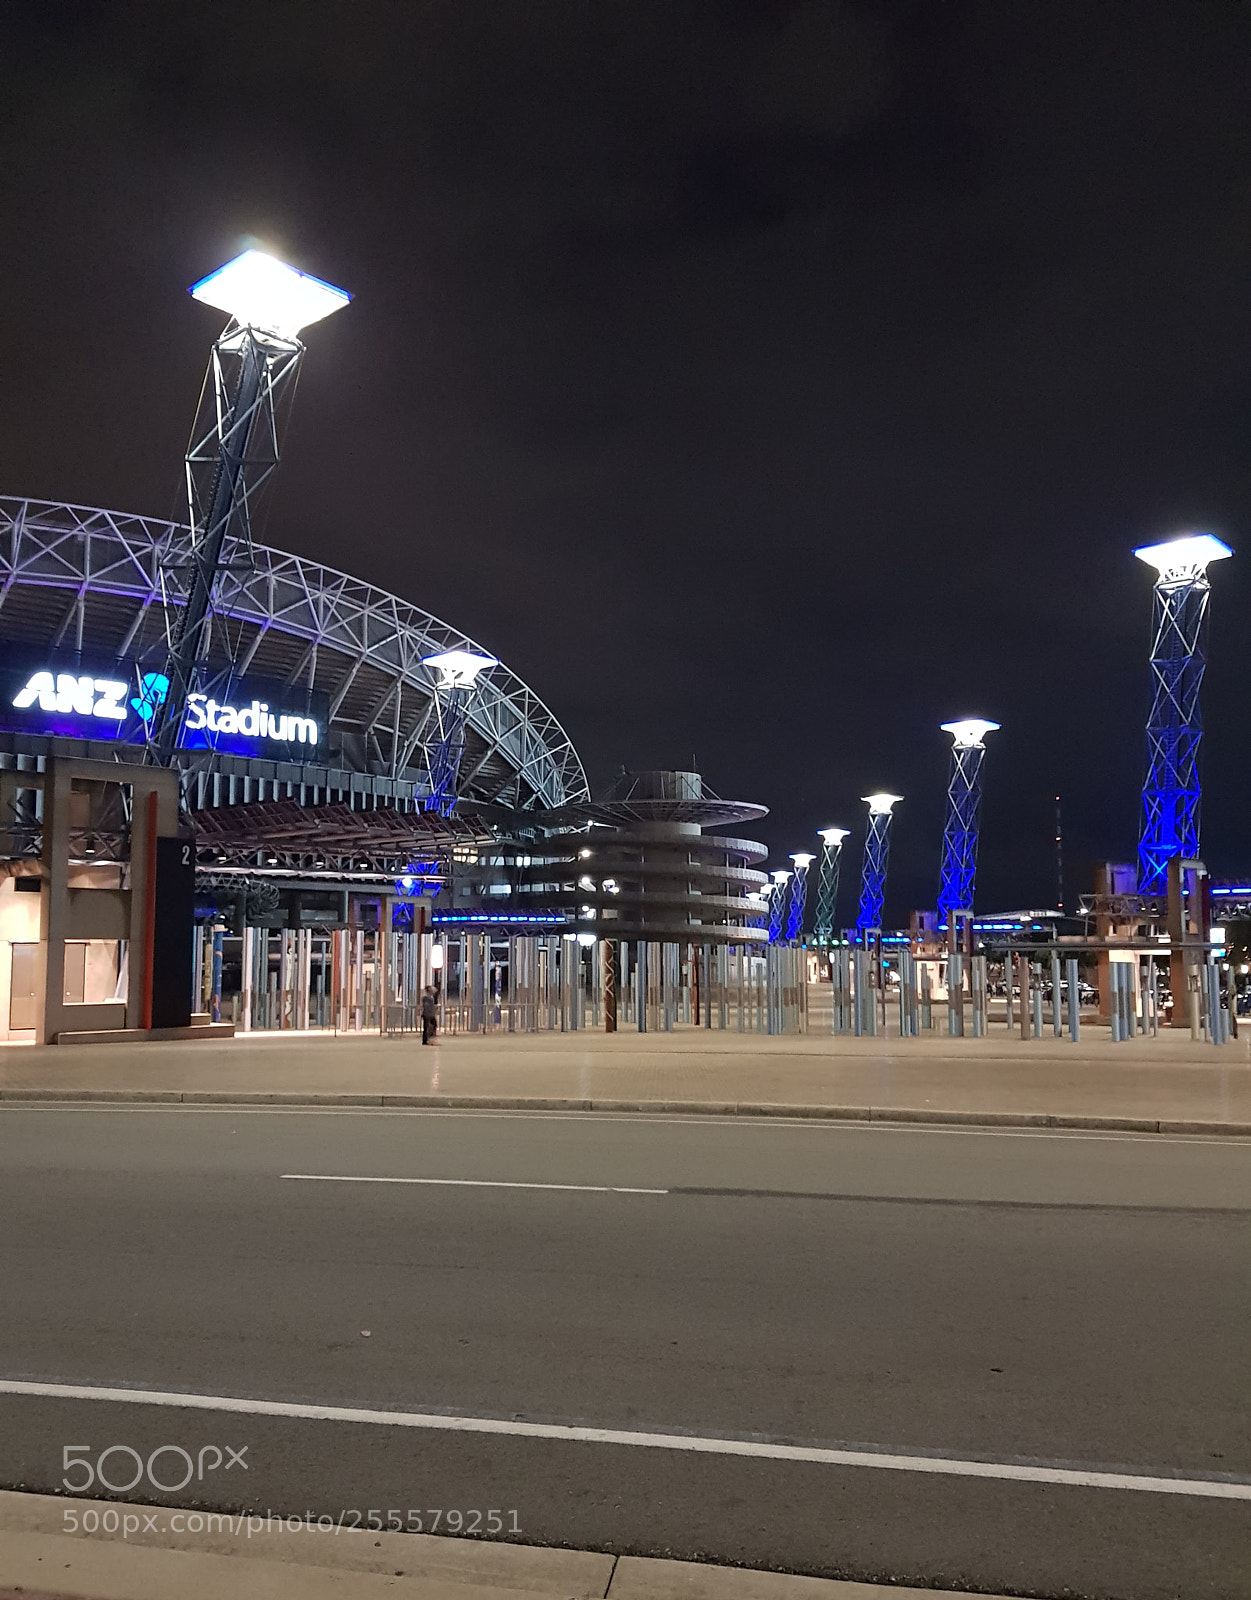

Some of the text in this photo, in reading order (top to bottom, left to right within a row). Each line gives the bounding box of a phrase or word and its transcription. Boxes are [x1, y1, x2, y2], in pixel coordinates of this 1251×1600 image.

[13, 671, 318, 745] ANZ Stadium
[181, 845, 191, 866] 2
